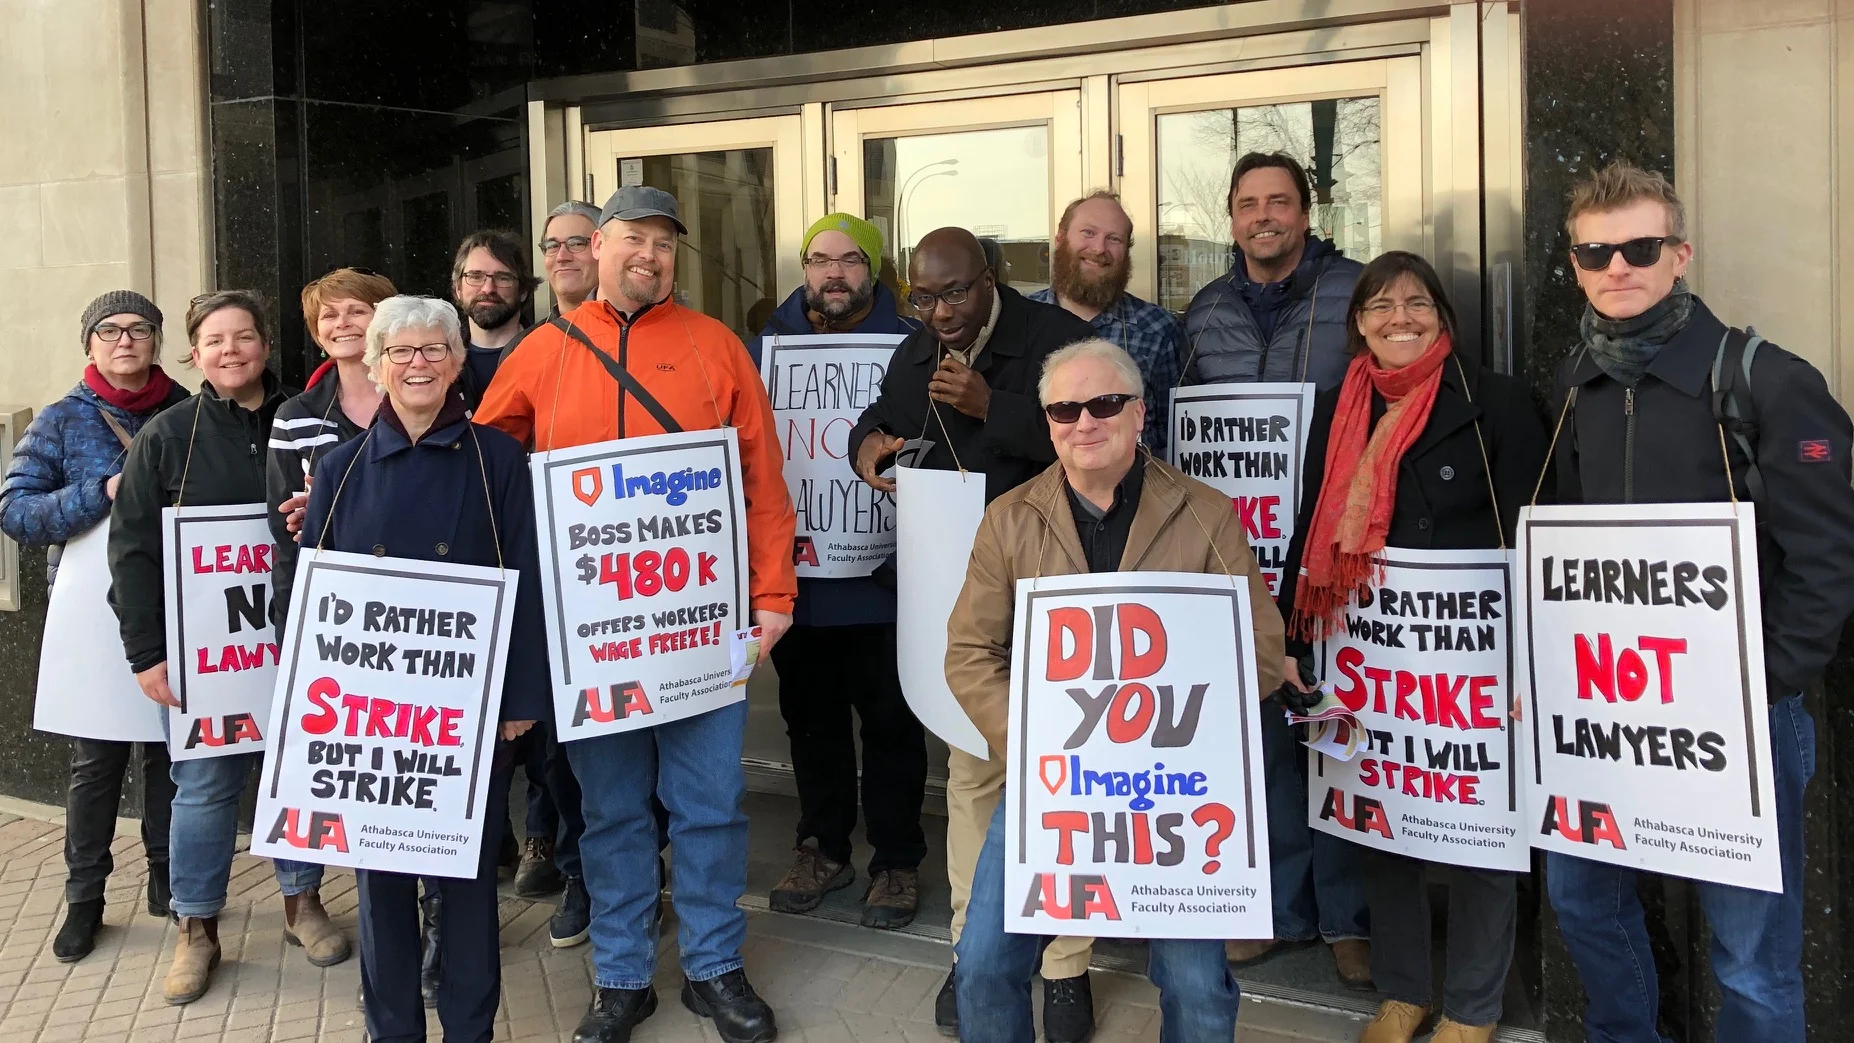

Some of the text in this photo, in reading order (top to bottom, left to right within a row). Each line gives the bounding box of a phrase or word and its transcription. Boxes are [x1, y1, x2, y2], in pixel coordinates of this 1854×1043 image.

[772, 362, 886, 410] LEARNER
[786, 417, 854, 461] NO
[1181, 410, 1291, 444] I'D RATHER
[612, 463, 722, 506] Imagine
[1180, 450, 1288, 481] WORK THAN
[796, 478, 897, 534] AWYERS
[568, 509, 722, 550] BOSS MAKES
[827, 543, 869, 551] Athabasca
[191, 543, 277, 574] LEAR
[827, 553, 856, 563] Faculty
[1379, 588, 1502, 621] RATHER
[1542, 555, 1729, 612] LEARNERS
[318, 592, 354, 626] I'D
[362, 601, 477, 640] RATHER
[577, 602, 729, 638] OFFERS WORKERS
[1345, 613, 1496, 652] WORK THAN
[315, 633, 476, 678] WORK THAN
[589, 621, 721, 663] WAGE FREEZE!
[1045, 602, 1168, 682] DID
[659, 668, 732, 691] Athabasca Univers
[1334, 646, 1506, 732] STRIKE.
[1574, 632, 1688, 705] NOT
[300, 676, 465, 748] STRIKE.
[571, 679, 655, 728] AUFA
[659, 691, 690, 704] Faculty
[1063, 682, 1211, 750] YOU
[184, 712, 263, 750] AUFA
[1552, 714, 1728, 773] LAWYERS
[307, 741, 462, 777] BUT I WILL
[1405, 735, 1415, 764] I
[1424, 738, 1501, 772] WILL
[310, 769, 438, 812] STRIKE.
[1070, 754, 1209, 811] Imagine
[1359, 758, 1486, 806] STRIKE.
[265, 807, 350, 853] AUFA
[1319, 786, 1395, 840] AUFA
[1401, 812, 1517, 838] Athabasca University
[1540, 794, 1628, 851] AUFA
[1633, 816, 1763, 849] Athabasca University
[359, 838, 458, 856] Faculty Association
[360, 824, 469, 845] Athabasca University
[1041, 802, 1236, 875] THIS?
[1401, 826, 1506, 849] Faculty Association
[1634, 833, 1752, 863] Faculty Association
[1020, 872, 1123, 921] AUFA
[1130, 884, 1258, 900] Athabasca University
[1131, 901, 1247, 916] Faculty Association
